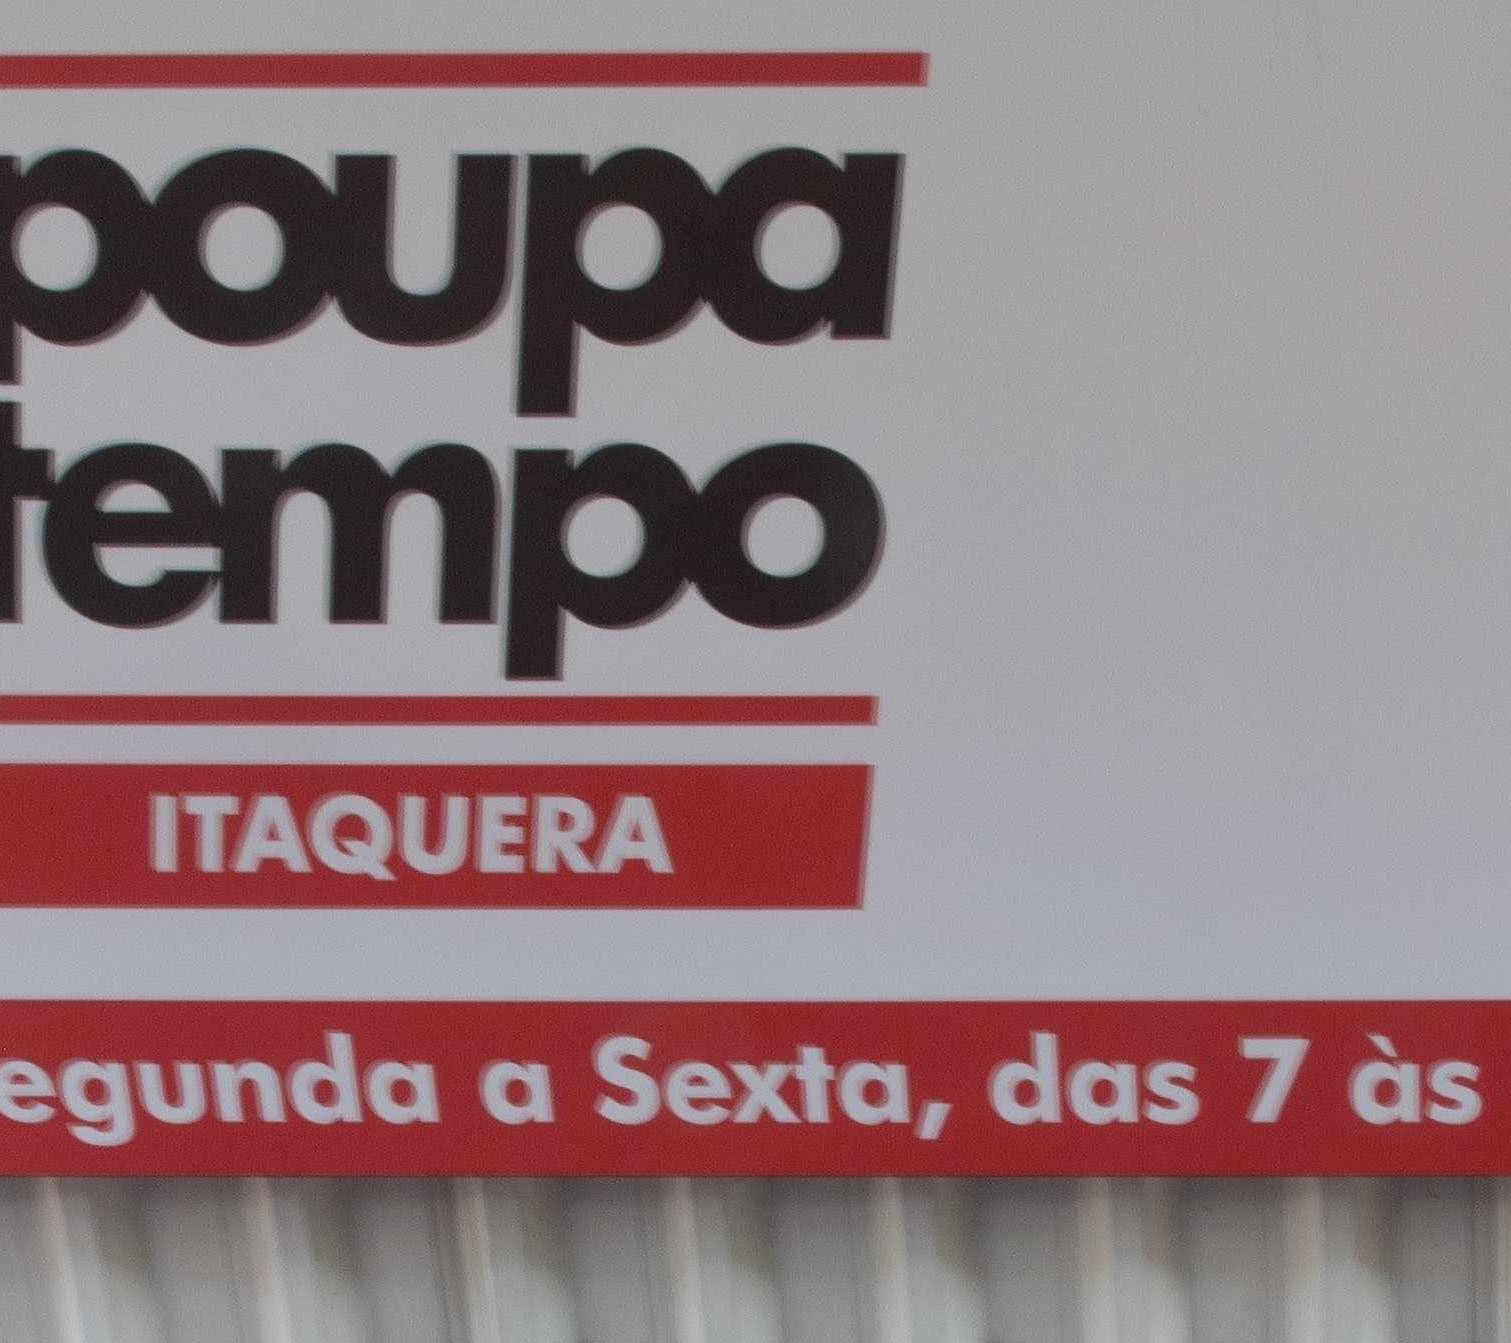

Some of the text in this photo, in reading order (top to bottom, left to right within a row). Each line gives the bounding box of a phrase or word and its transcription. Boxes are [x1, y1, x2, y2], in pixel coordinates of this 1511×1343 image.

[148, 792, 675, 881] ITAQUERA
[477, 1059, 556, 1126] a
[591, 1033, 954, 1141] Sexta,
[987, 1030, 1202, 1127] das
[1237, 1035, 1312, 1125] 7
[1347, 1033, 1485, 1127] às
